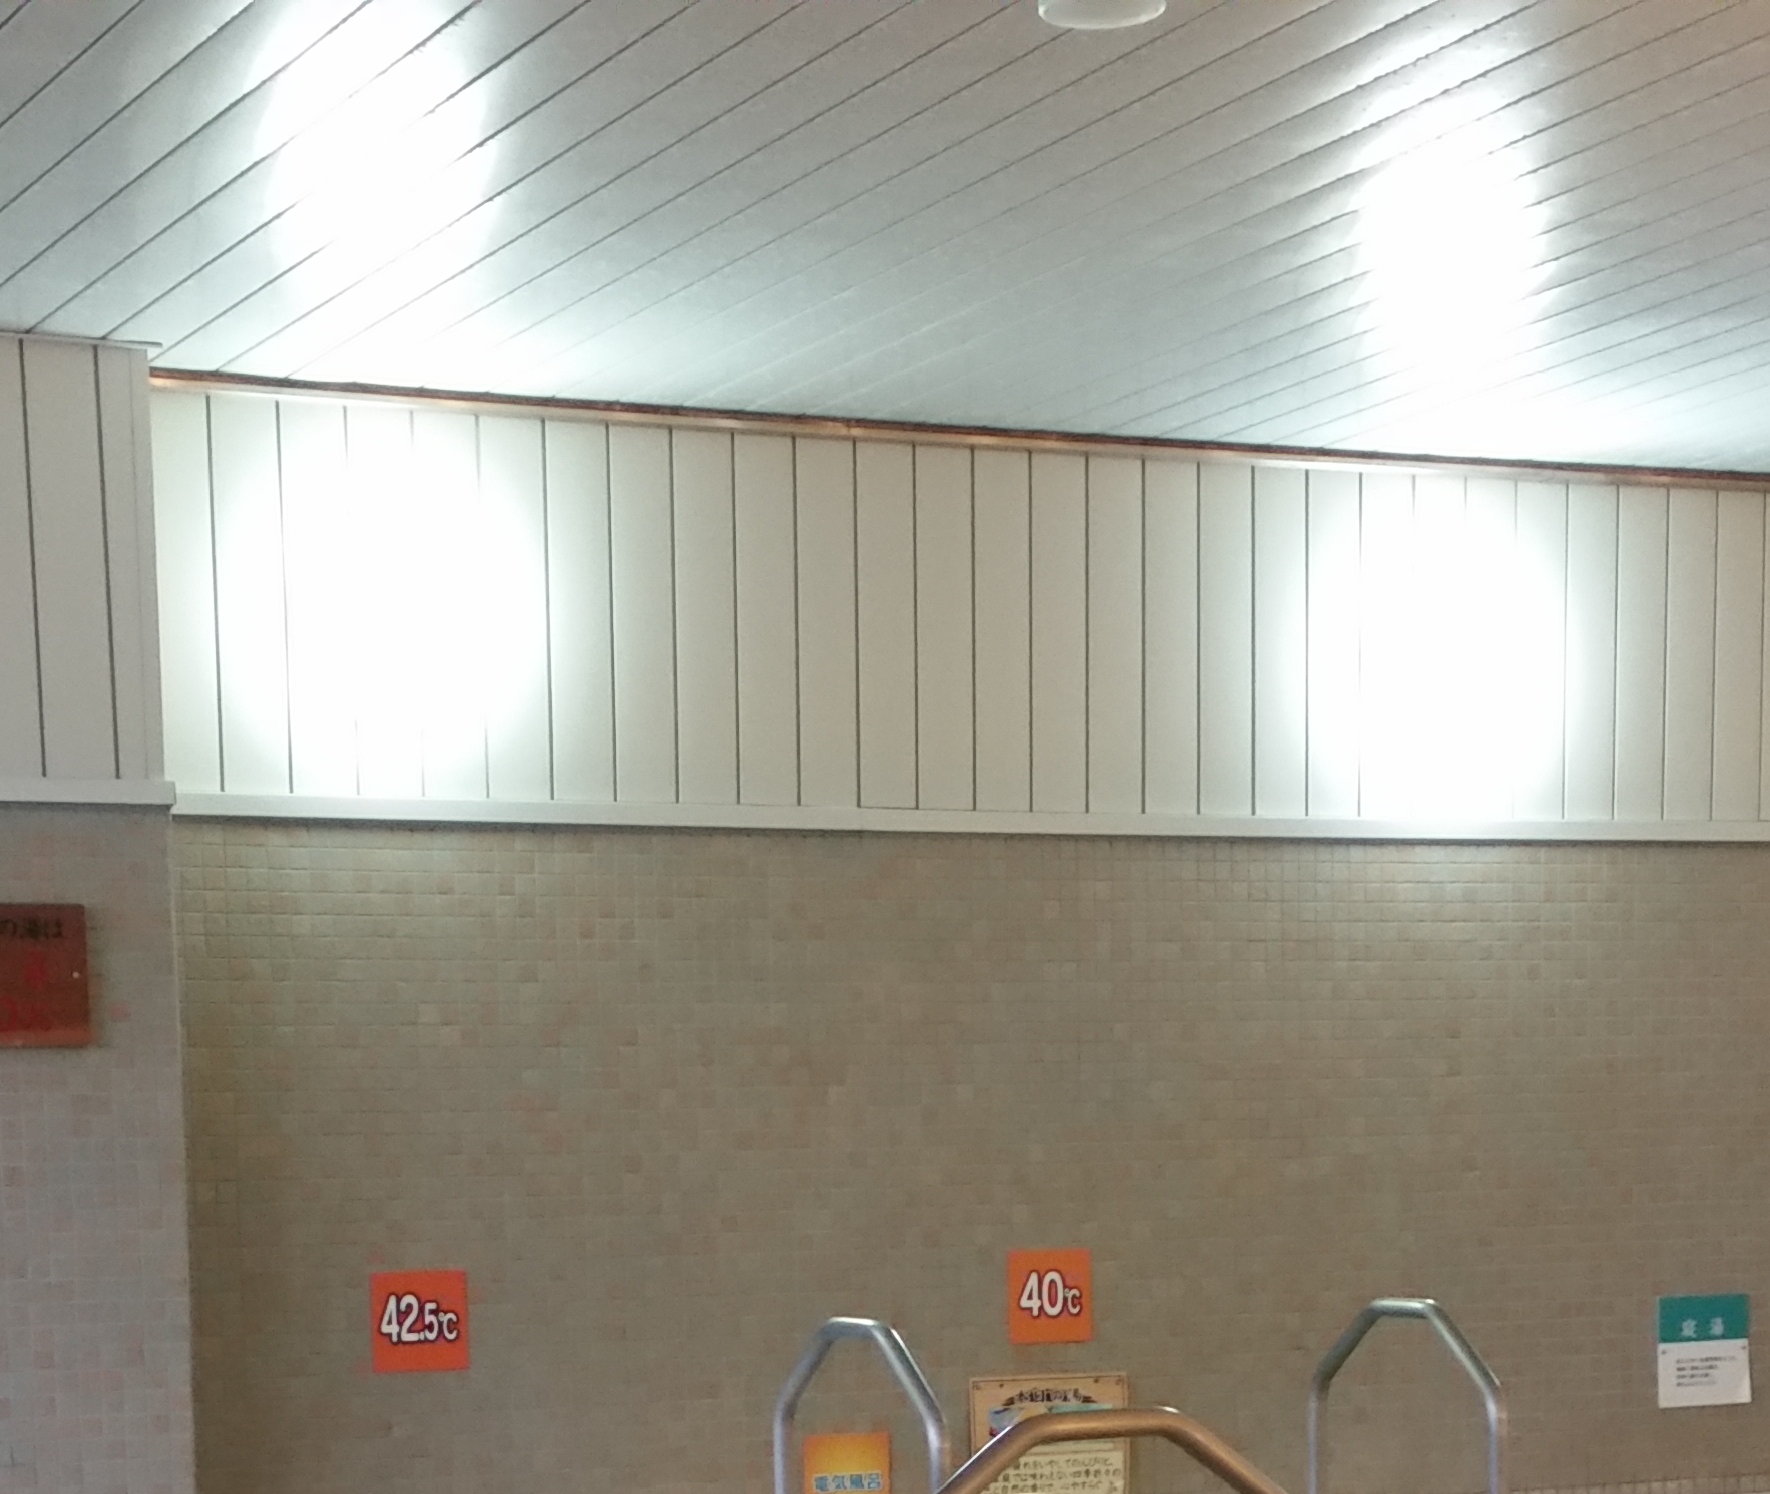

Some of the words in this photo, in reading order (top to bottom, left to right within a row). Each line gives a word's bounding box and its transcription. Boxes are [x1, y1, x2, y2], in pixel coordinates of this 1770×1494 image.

[380, 1293, 459, 1344] 42.5℃
[813, 1472, 882, 1492] 電気風呂
